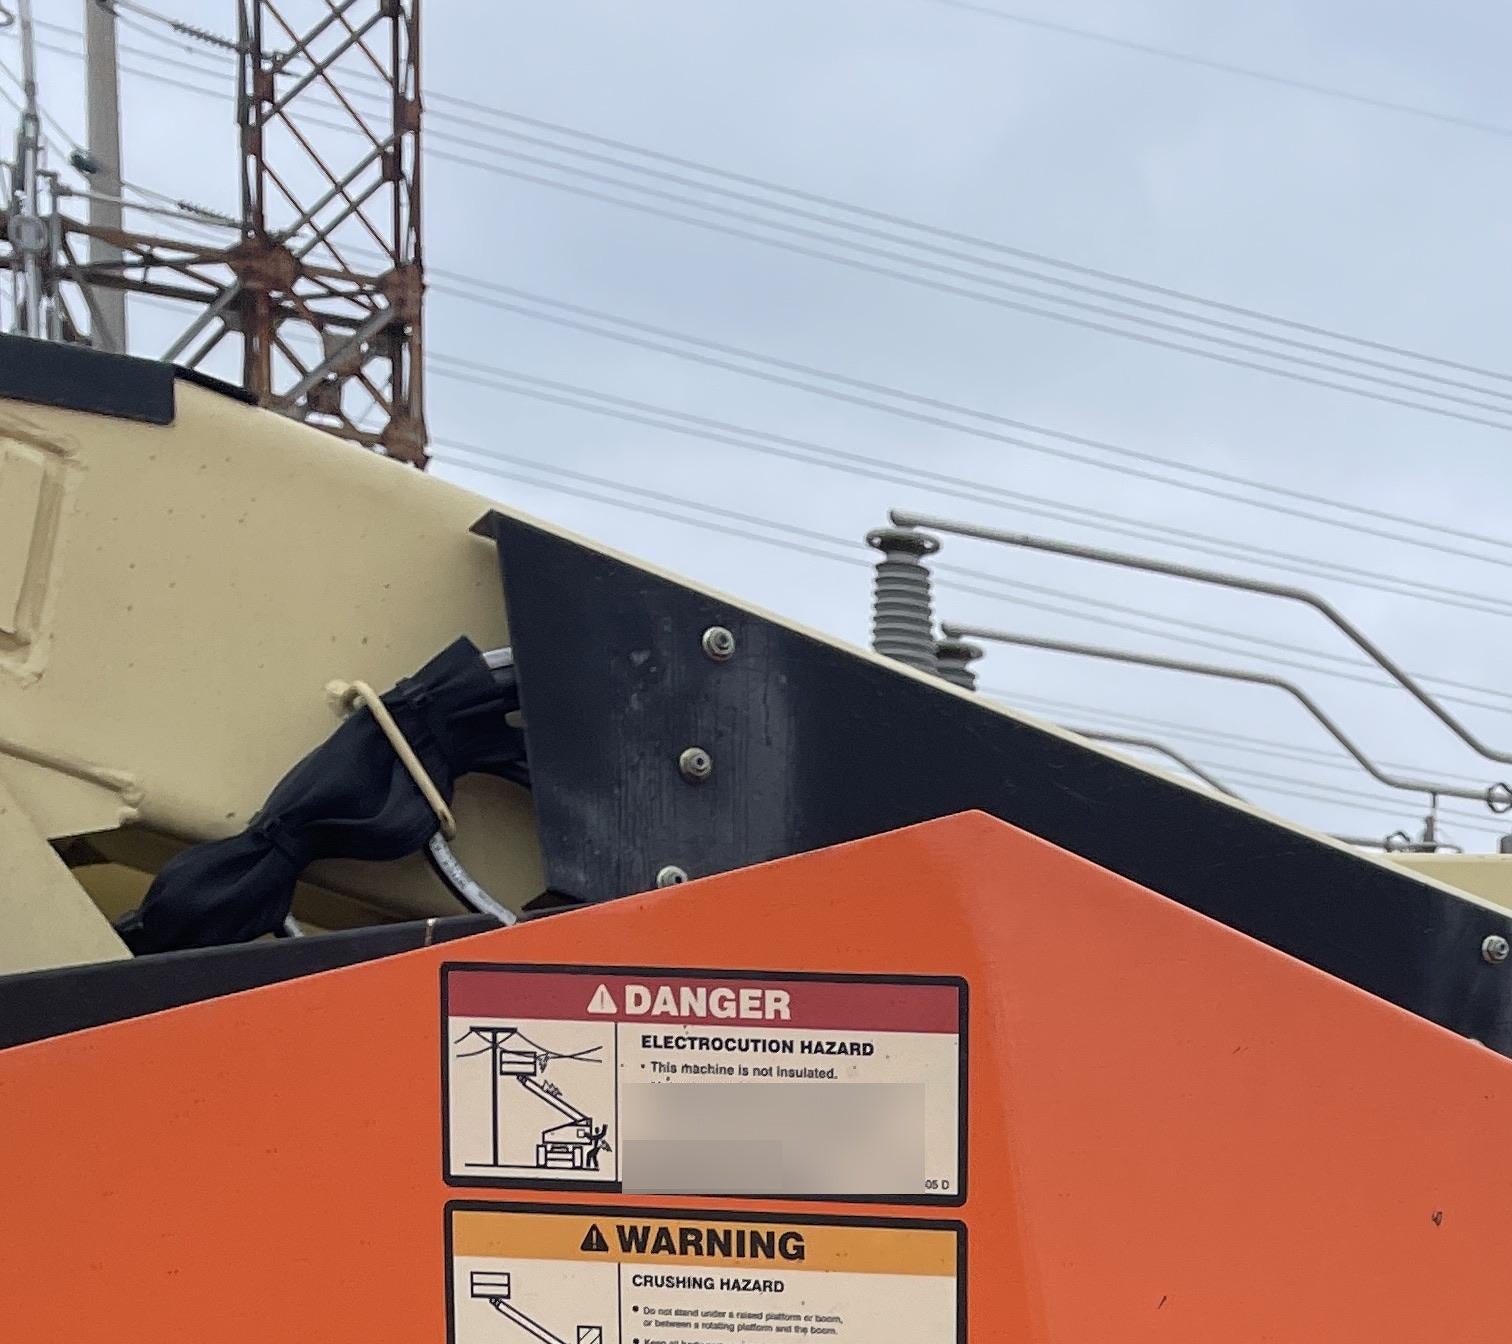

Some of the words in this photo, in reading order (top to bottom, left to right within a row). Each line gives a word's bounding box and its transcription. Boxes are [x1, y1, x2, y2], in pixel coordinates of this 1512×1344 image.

[625, 984, 792, 1020] DANGER
[641, 1034, 794, 1054] ELECTROCUTION
[800, 1041, 875, 1056] HAZARD
[651, 1061, 678, 1074] This
[681, 1063, 735, 1076] machine
[738, 1065, 750, 1077] is
[753, 1066, 773, 1077] not
[776, 1066, 838, 1079] insulated.
[941, 1179, 950, 1190] D
[616, 1224, 806, 1261] WARNING
[632, 1274, 715, 1290] CRUSHING
[719, 1278, 785, 1293] HAZARD
[643, 1306, 656, 1315] Do
[658, 1307, 673, 1316] not
[674, 1307, 699, 1317] stand
[700, 1308, 727, 1318] under
[736, 1310, 763, 1319] raised
[765, 1312, 802, 1323] platform
[643, 1320, 653, 1328] or
[654, 1319, 692, 1329] between
[701, 1321, 735, 1332] rotating
[737, 1323, 773, 1333] platform
[775, 1324, 792, 1333] and
[794, 1324, 809, 1334] the
